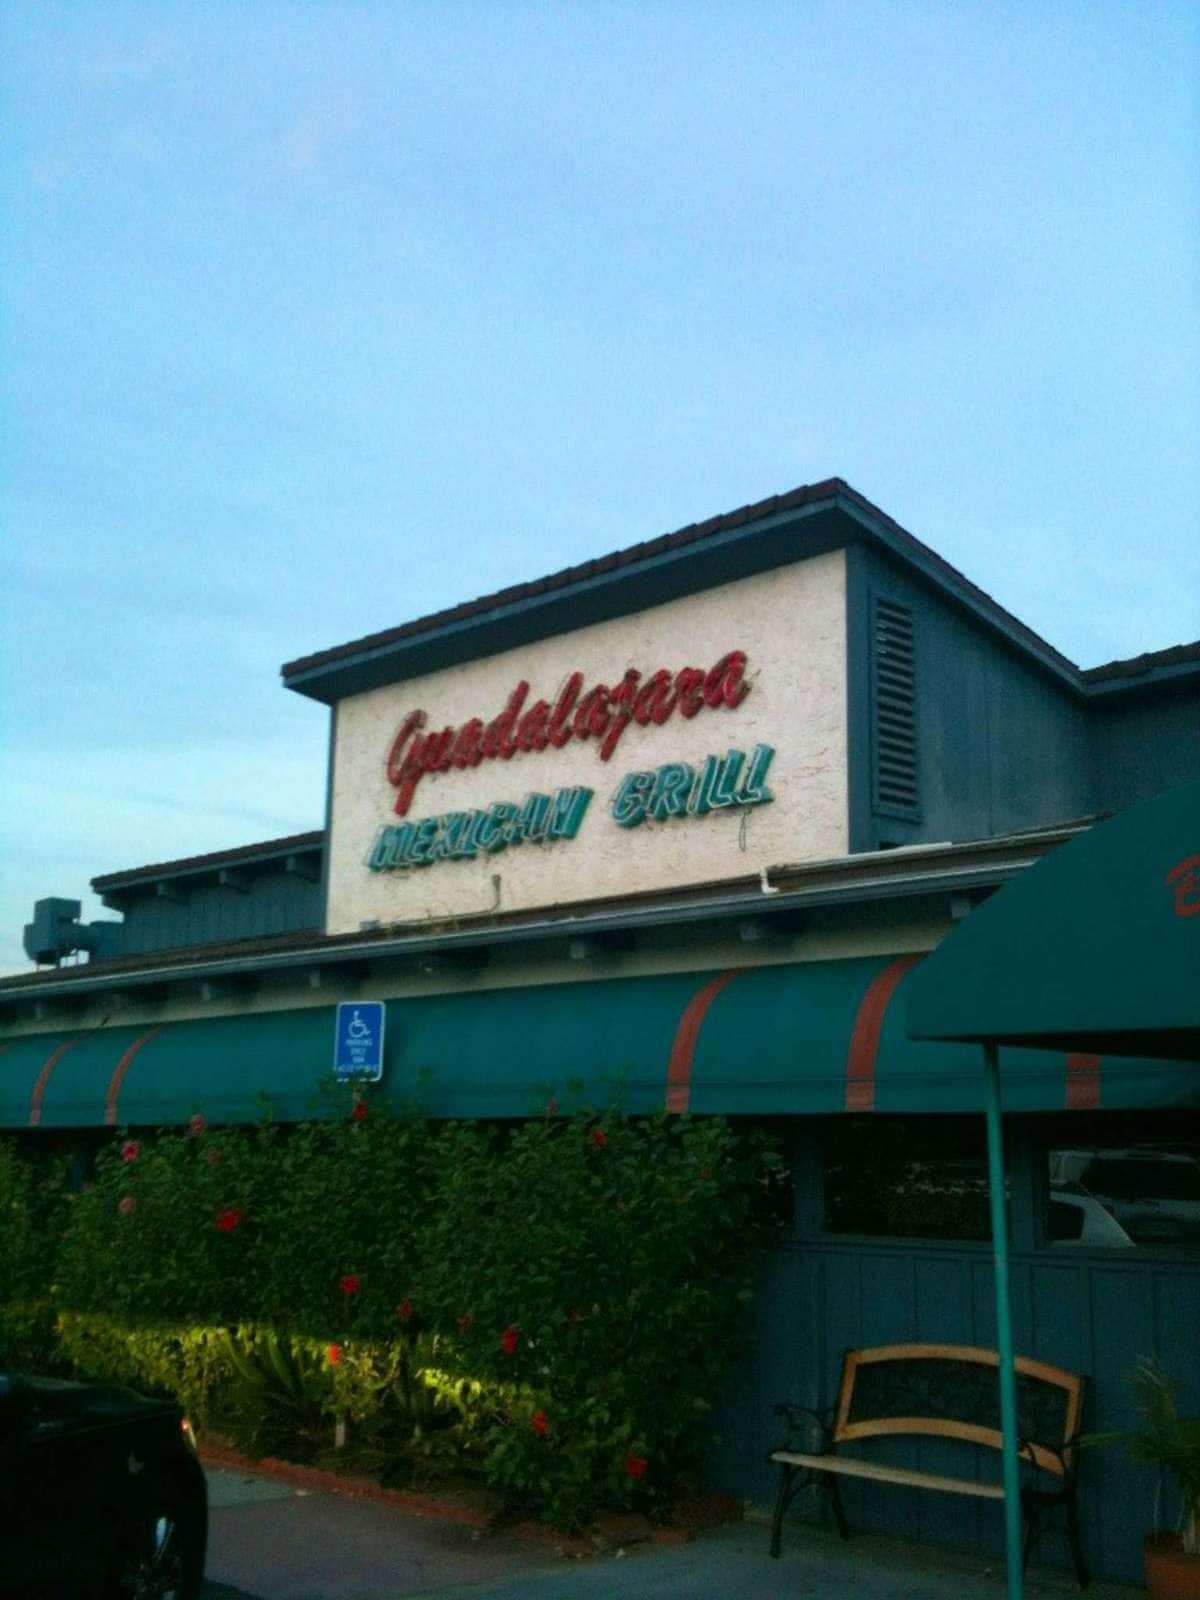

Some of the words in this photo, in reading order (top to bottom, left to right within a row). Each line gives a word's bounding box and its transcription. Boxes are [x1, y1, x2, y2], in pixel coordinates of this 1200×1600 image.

[367, 786, 595, 872] MEXICAN
[610, 743, 776, 828] GRILL
[387, 650, 749, 817] Guadalajara
